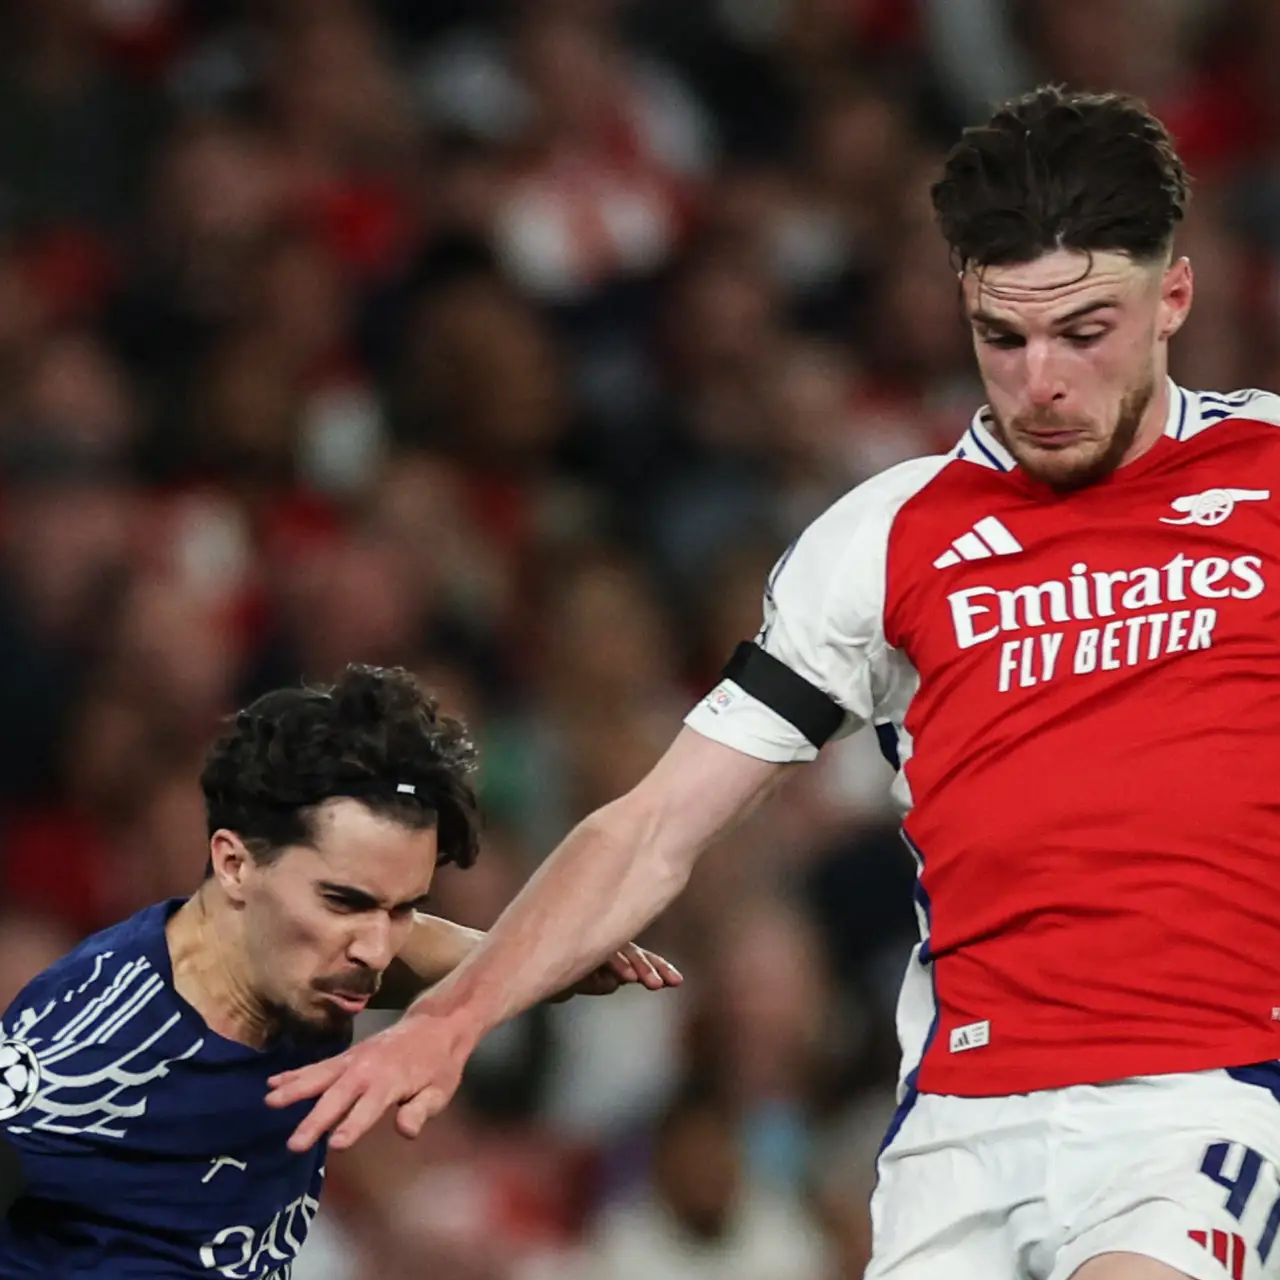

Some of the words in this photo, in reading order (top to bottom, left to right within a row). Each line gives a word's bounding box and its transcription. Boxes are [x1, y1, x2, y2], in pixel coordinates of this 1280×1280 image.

[946, 553, 1265, 650] Emirates
[998, 632, 1063, 692] FLY
[1073, 608, 1217, 675] BETTER
